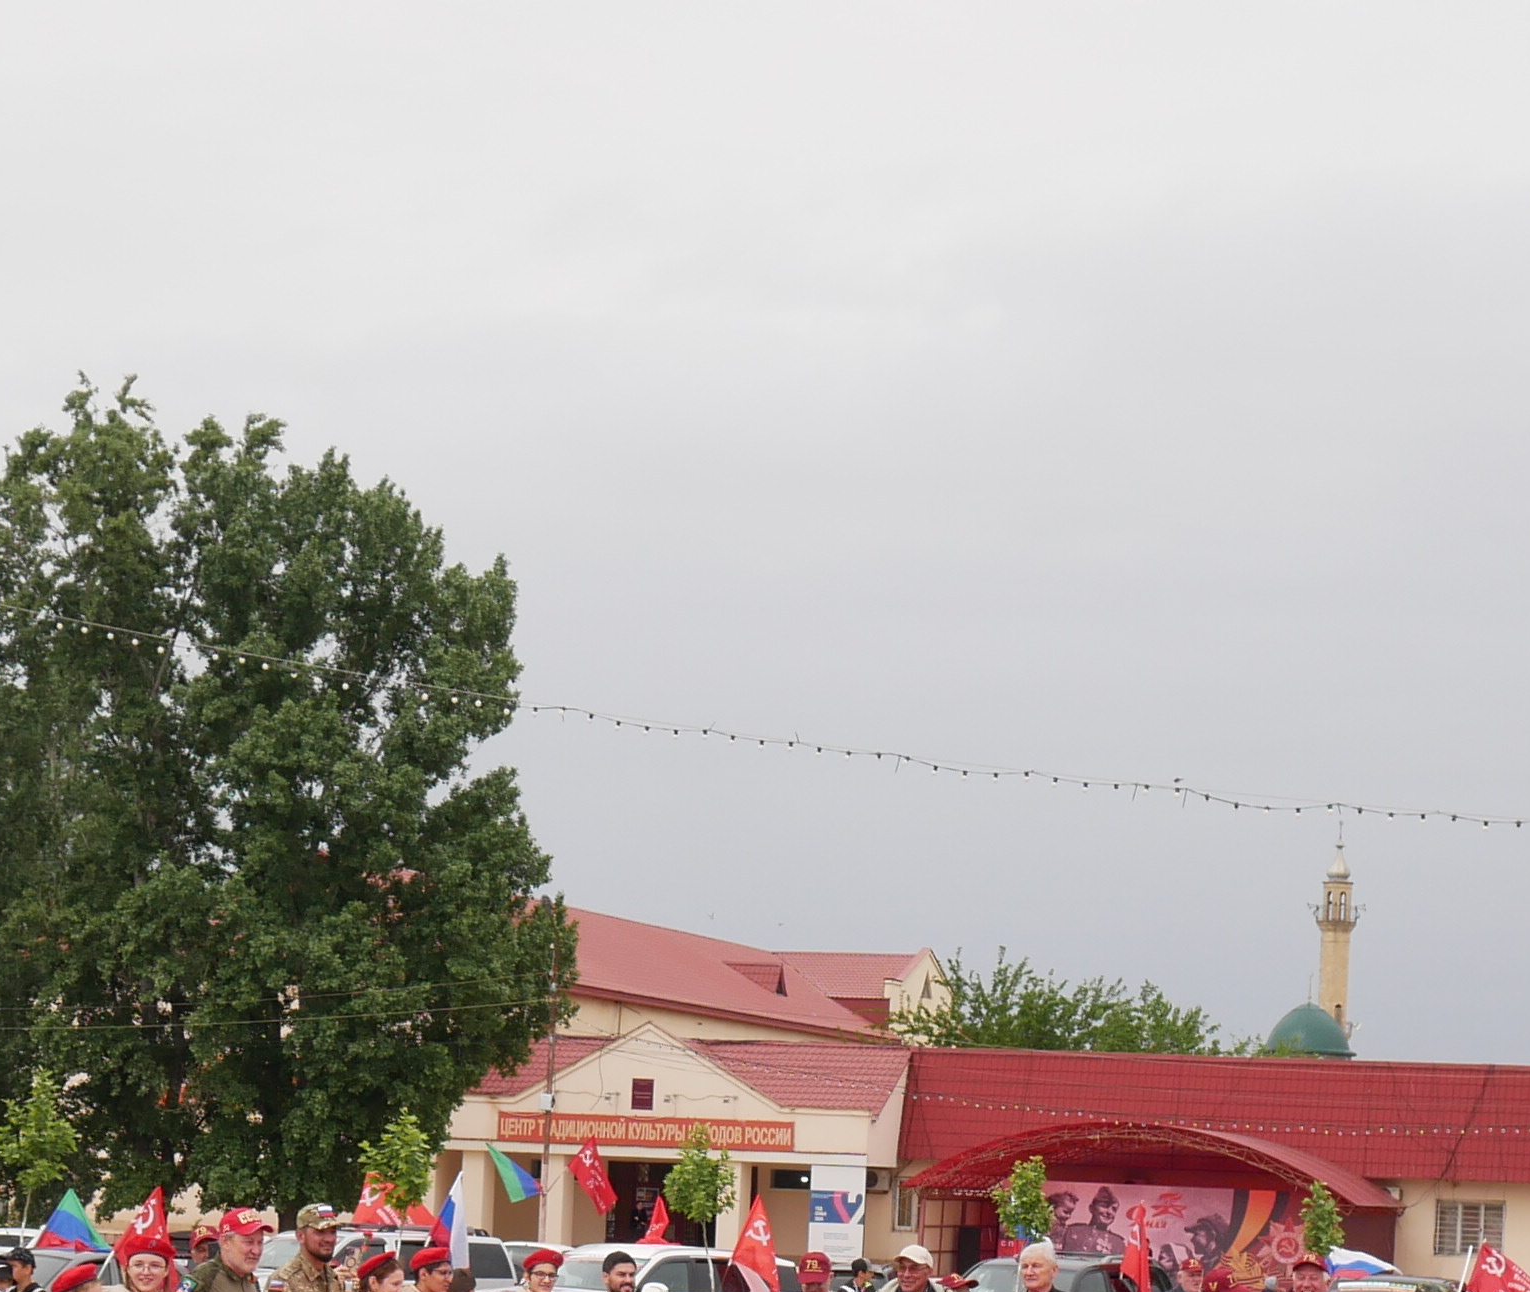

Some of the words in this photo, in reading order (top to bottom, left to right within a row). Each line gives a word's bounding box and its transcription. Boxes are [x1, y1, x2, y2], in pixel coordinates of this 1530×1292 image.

[500, 1117, 536, 1139] ЦЕНТР
[537, 1117, 626, 1141] ТАДИЦИОННОЙ
[628, 1122, 686, 1142] КУЛЬТУРЫ
[744, 1127, 792, 1146] РОССИИ
[1208, 1281, 1219, 1292] V
